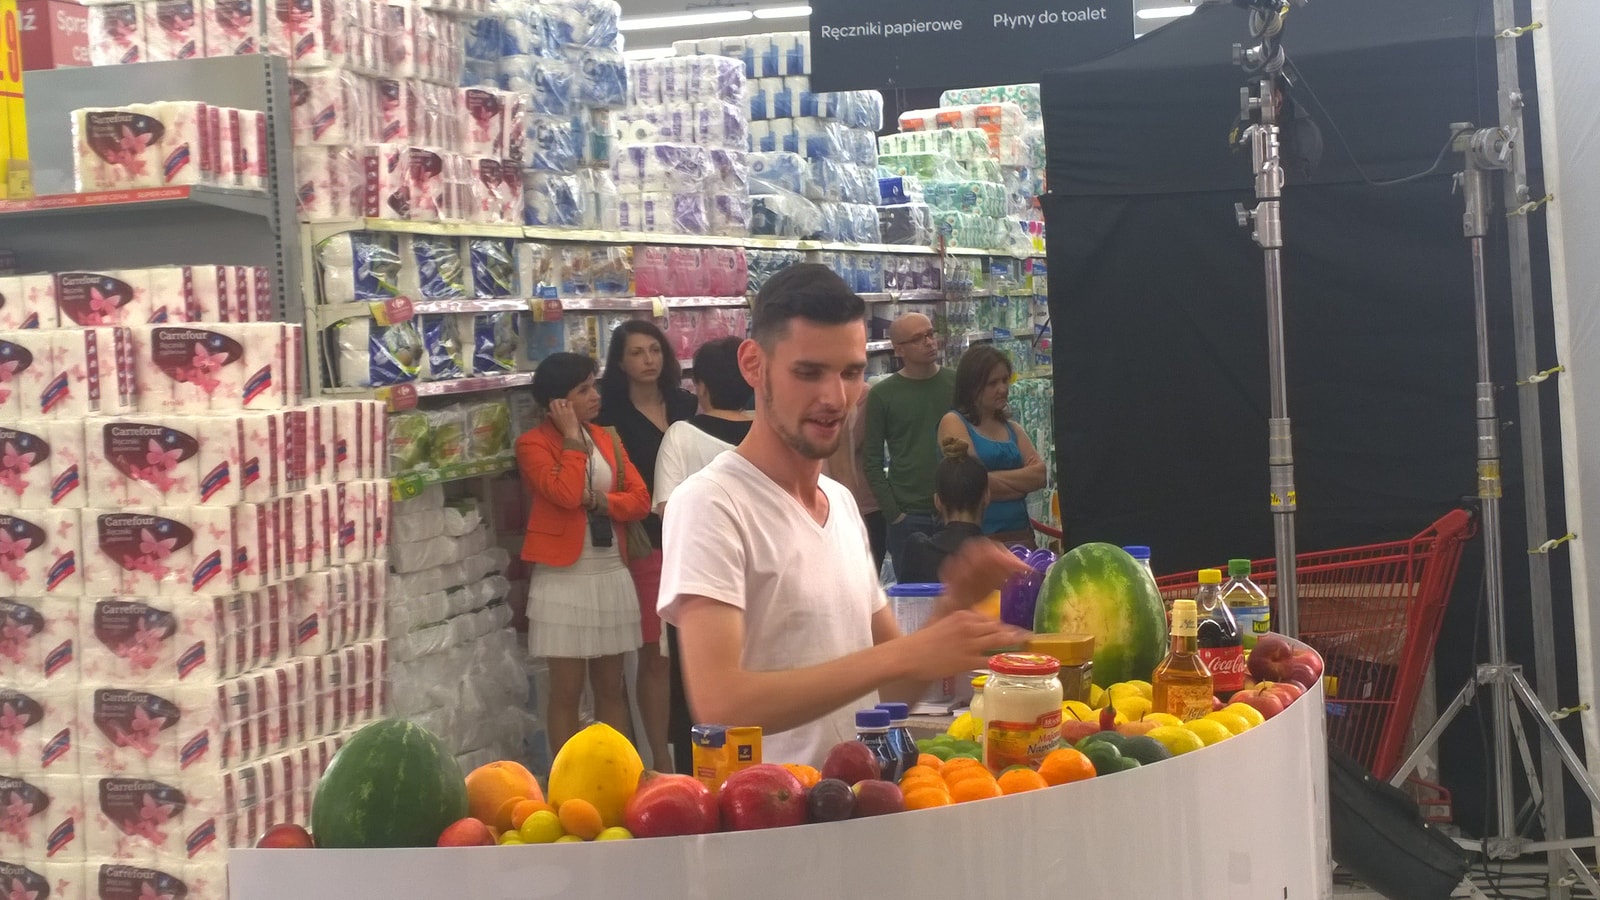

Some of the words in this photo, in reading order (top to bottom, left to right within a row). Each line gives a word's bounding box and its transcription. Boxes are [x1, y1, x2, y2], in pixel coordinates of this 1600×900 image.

[57, 10, 88, 36] Spra
[993, 13, 1036, 29] Płyny
[1038, 9, 1058, 23] do
[1061, 7, 1107, 22] toalet
[821, 22, 882, 39] Ręczniki
[884, 18, 963, 37] papierowe
[159, 331, 208, 340] Carrefour
[112, 427, 162, 436] Carrefour
[105, 517, 154, 526] Carrefour
[106, 867, 155, 879] Carrefour
